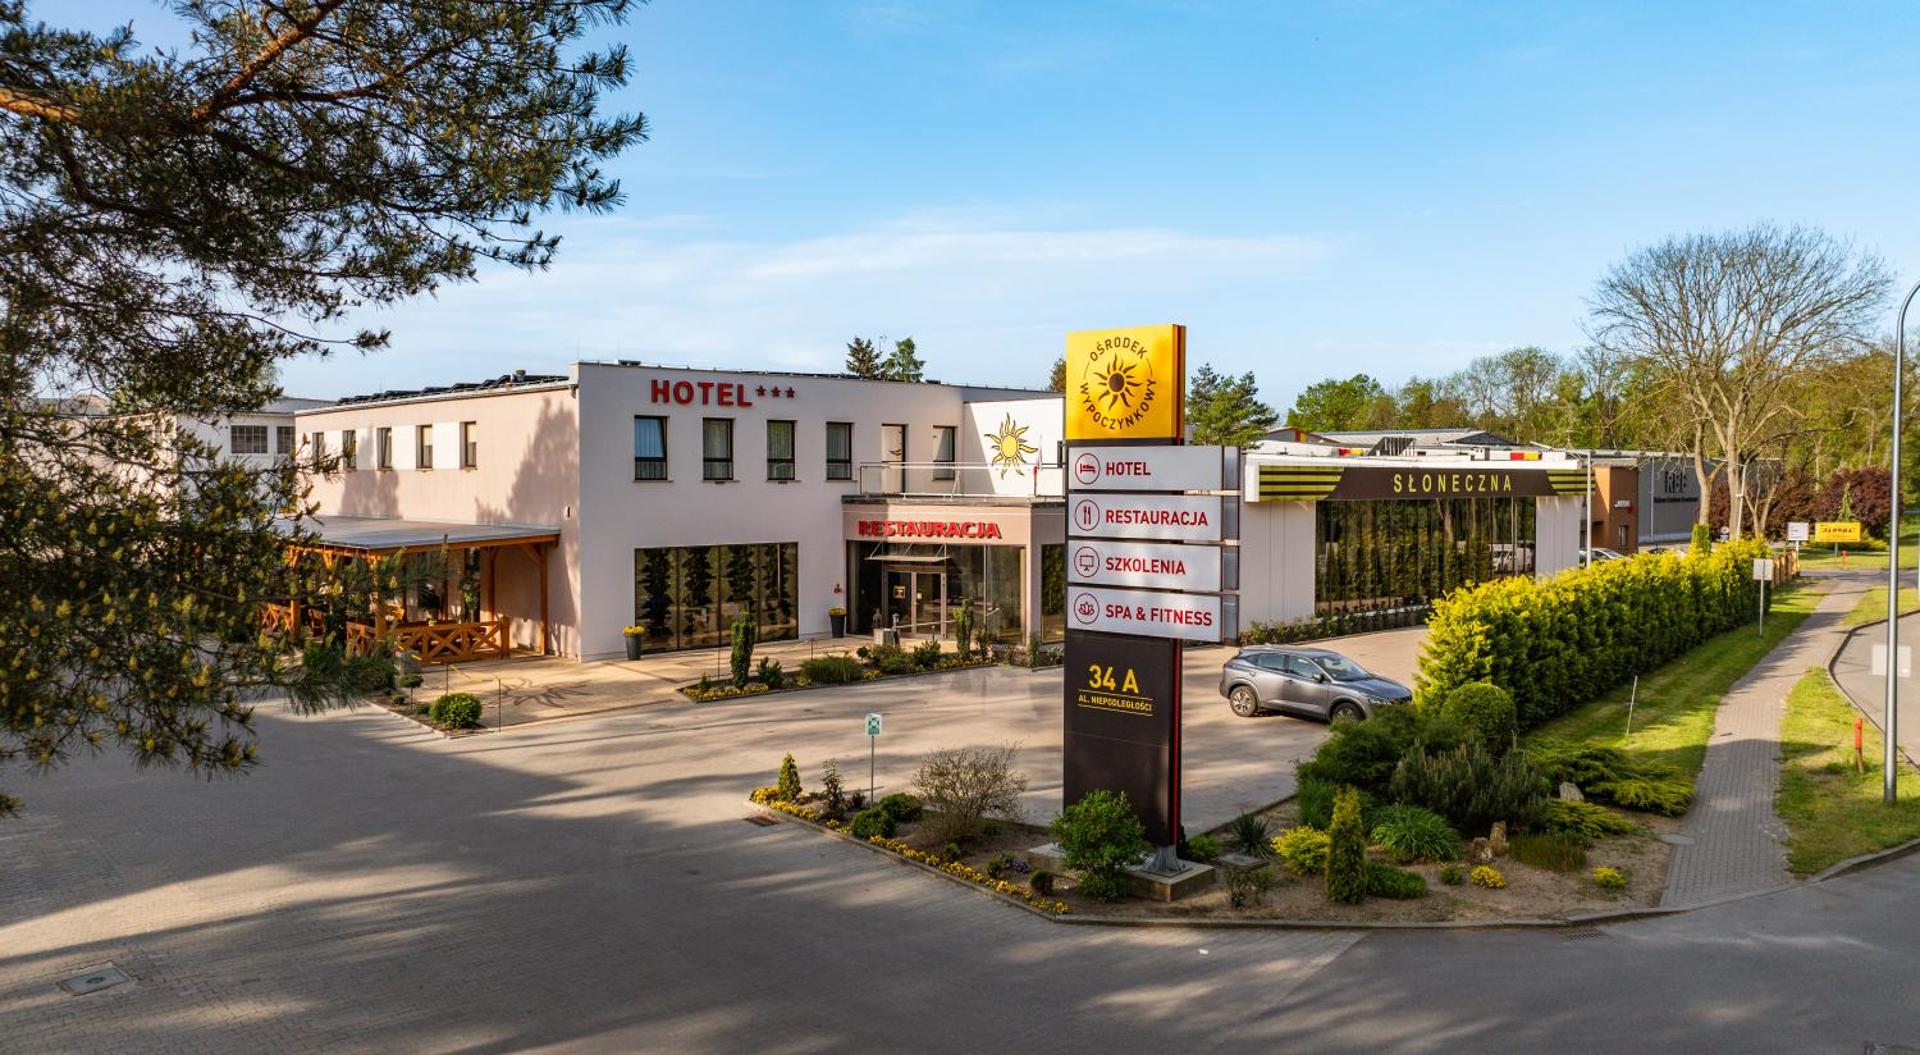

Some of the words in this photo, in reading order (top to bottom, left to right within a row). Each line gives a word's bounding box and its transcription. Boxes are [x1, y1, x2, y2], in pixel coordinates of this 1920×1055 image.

[1089, 336, 1147, 361] OŚRODEK
[651, 379, 753, 407] HOTEL
[1080, 378, 1157, 430] WYPOCZYNKOWY
[1105, 461, 1151, 476] HOTEL
[1393, 473, 1512, 493] SŁONECZNA
[1105, 509, 1208, 527] RESTAURACJA
[858, 520, 1002, 539] RESTAURACJA
[1105, 557, 1186, 575] SZKOLENIA
[1105, 604, 1132, 620] SPA
[1136, 606, 1146, 621] &
[1151, 608, 1212, 627] FITNESS
[1088, 664, 1117, 691] 34
[1122, 668, 1139, 694] A
[1078, 694, 1090, 704] AL.
[1091, 695, 1152, 712] NIEPODLEGŁOŚCI
